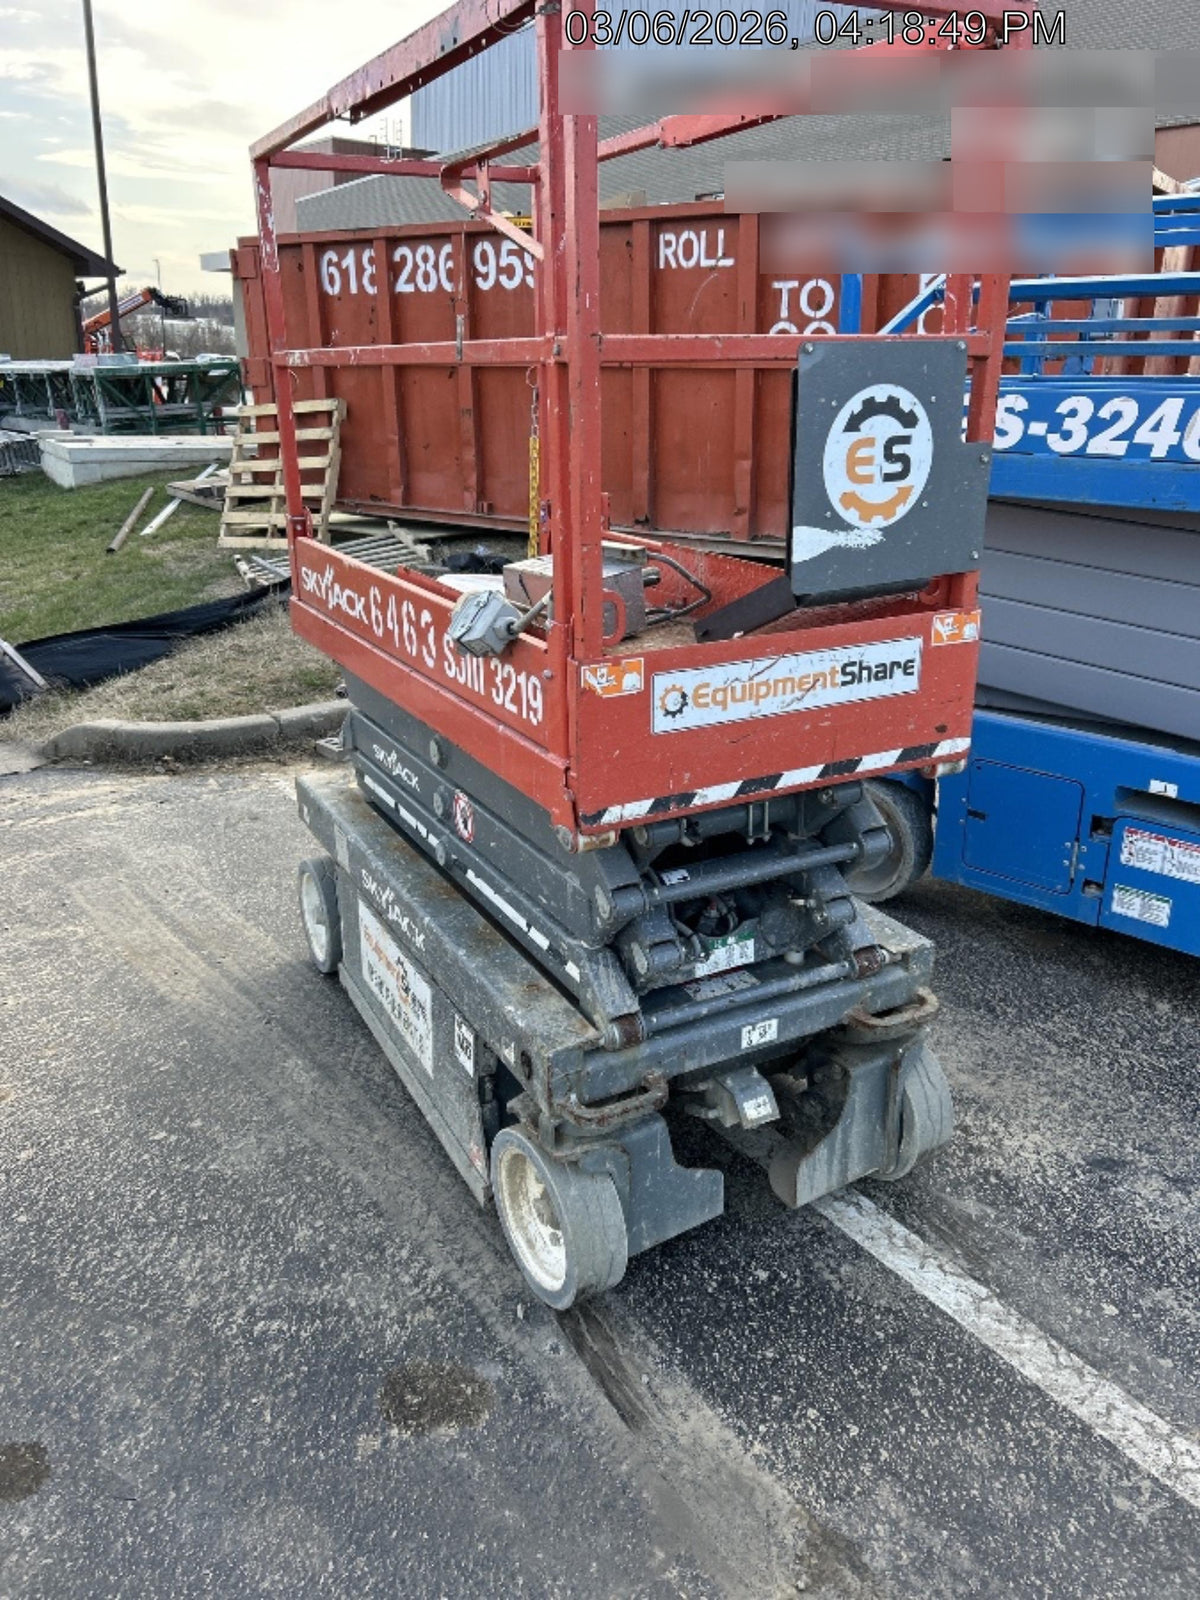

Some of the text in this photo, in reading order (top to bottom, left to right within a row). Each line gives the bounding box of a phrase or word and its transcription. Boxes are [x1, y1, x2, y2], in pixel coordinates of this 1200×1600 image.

[321, 249, 377, 296] 618
[393, 243, 455, 293] 286
[659, 229, 735, 269] ROLL
[772, 278, 835, 319] TO
[846, 434, 912, 484] ES
[301, 563, 369, 625] SKYJACK
[489, 657, 543, 726] 3219
[690, 657, 916, 712] EquipmentShare
